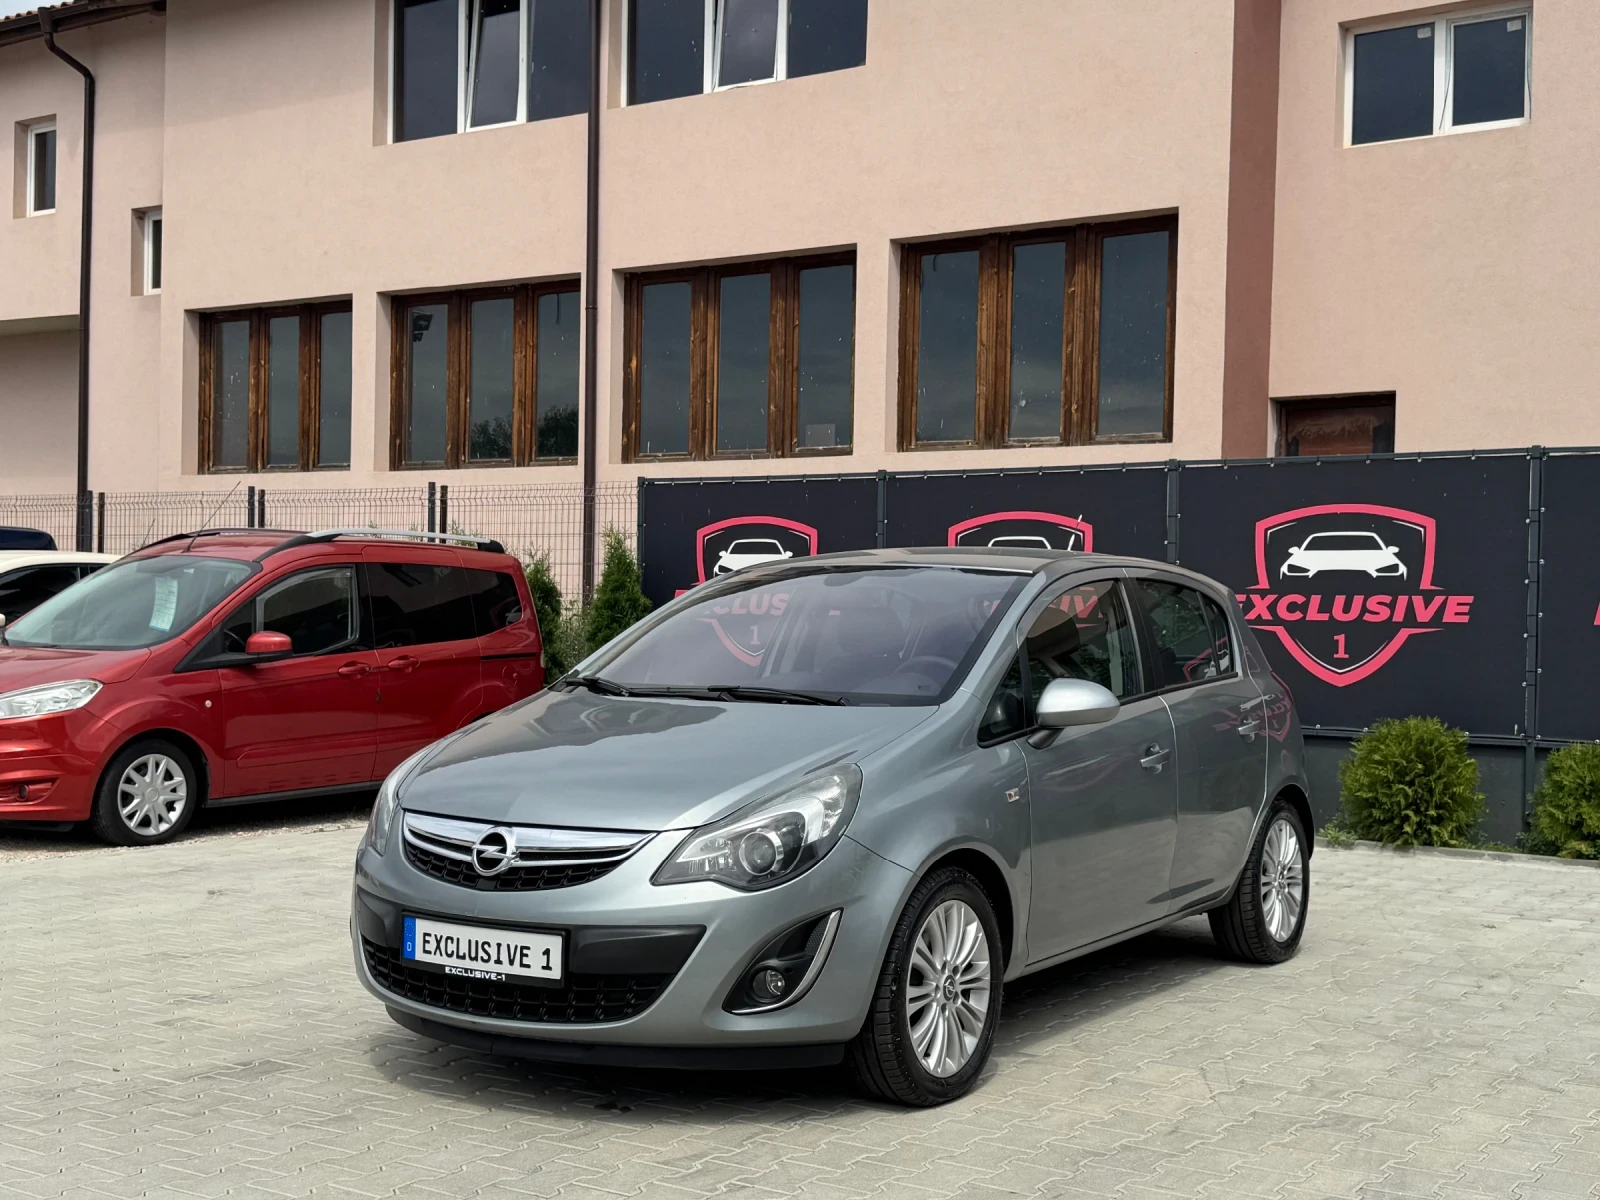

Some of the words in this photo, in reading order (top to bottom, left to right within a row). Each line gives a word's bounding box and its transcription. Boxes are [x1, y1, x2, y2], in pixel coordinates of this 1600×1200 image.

[750, 625, 761, 645] 1
[1333, 634, 1349, 659] 1
[406, 941, 413, 952] D
[422, 932, 531, 969] EXCLUSIVE
[541, 947, 553, 971] 1
[445, 966, 506, 982] EXCLUSIVE-1
